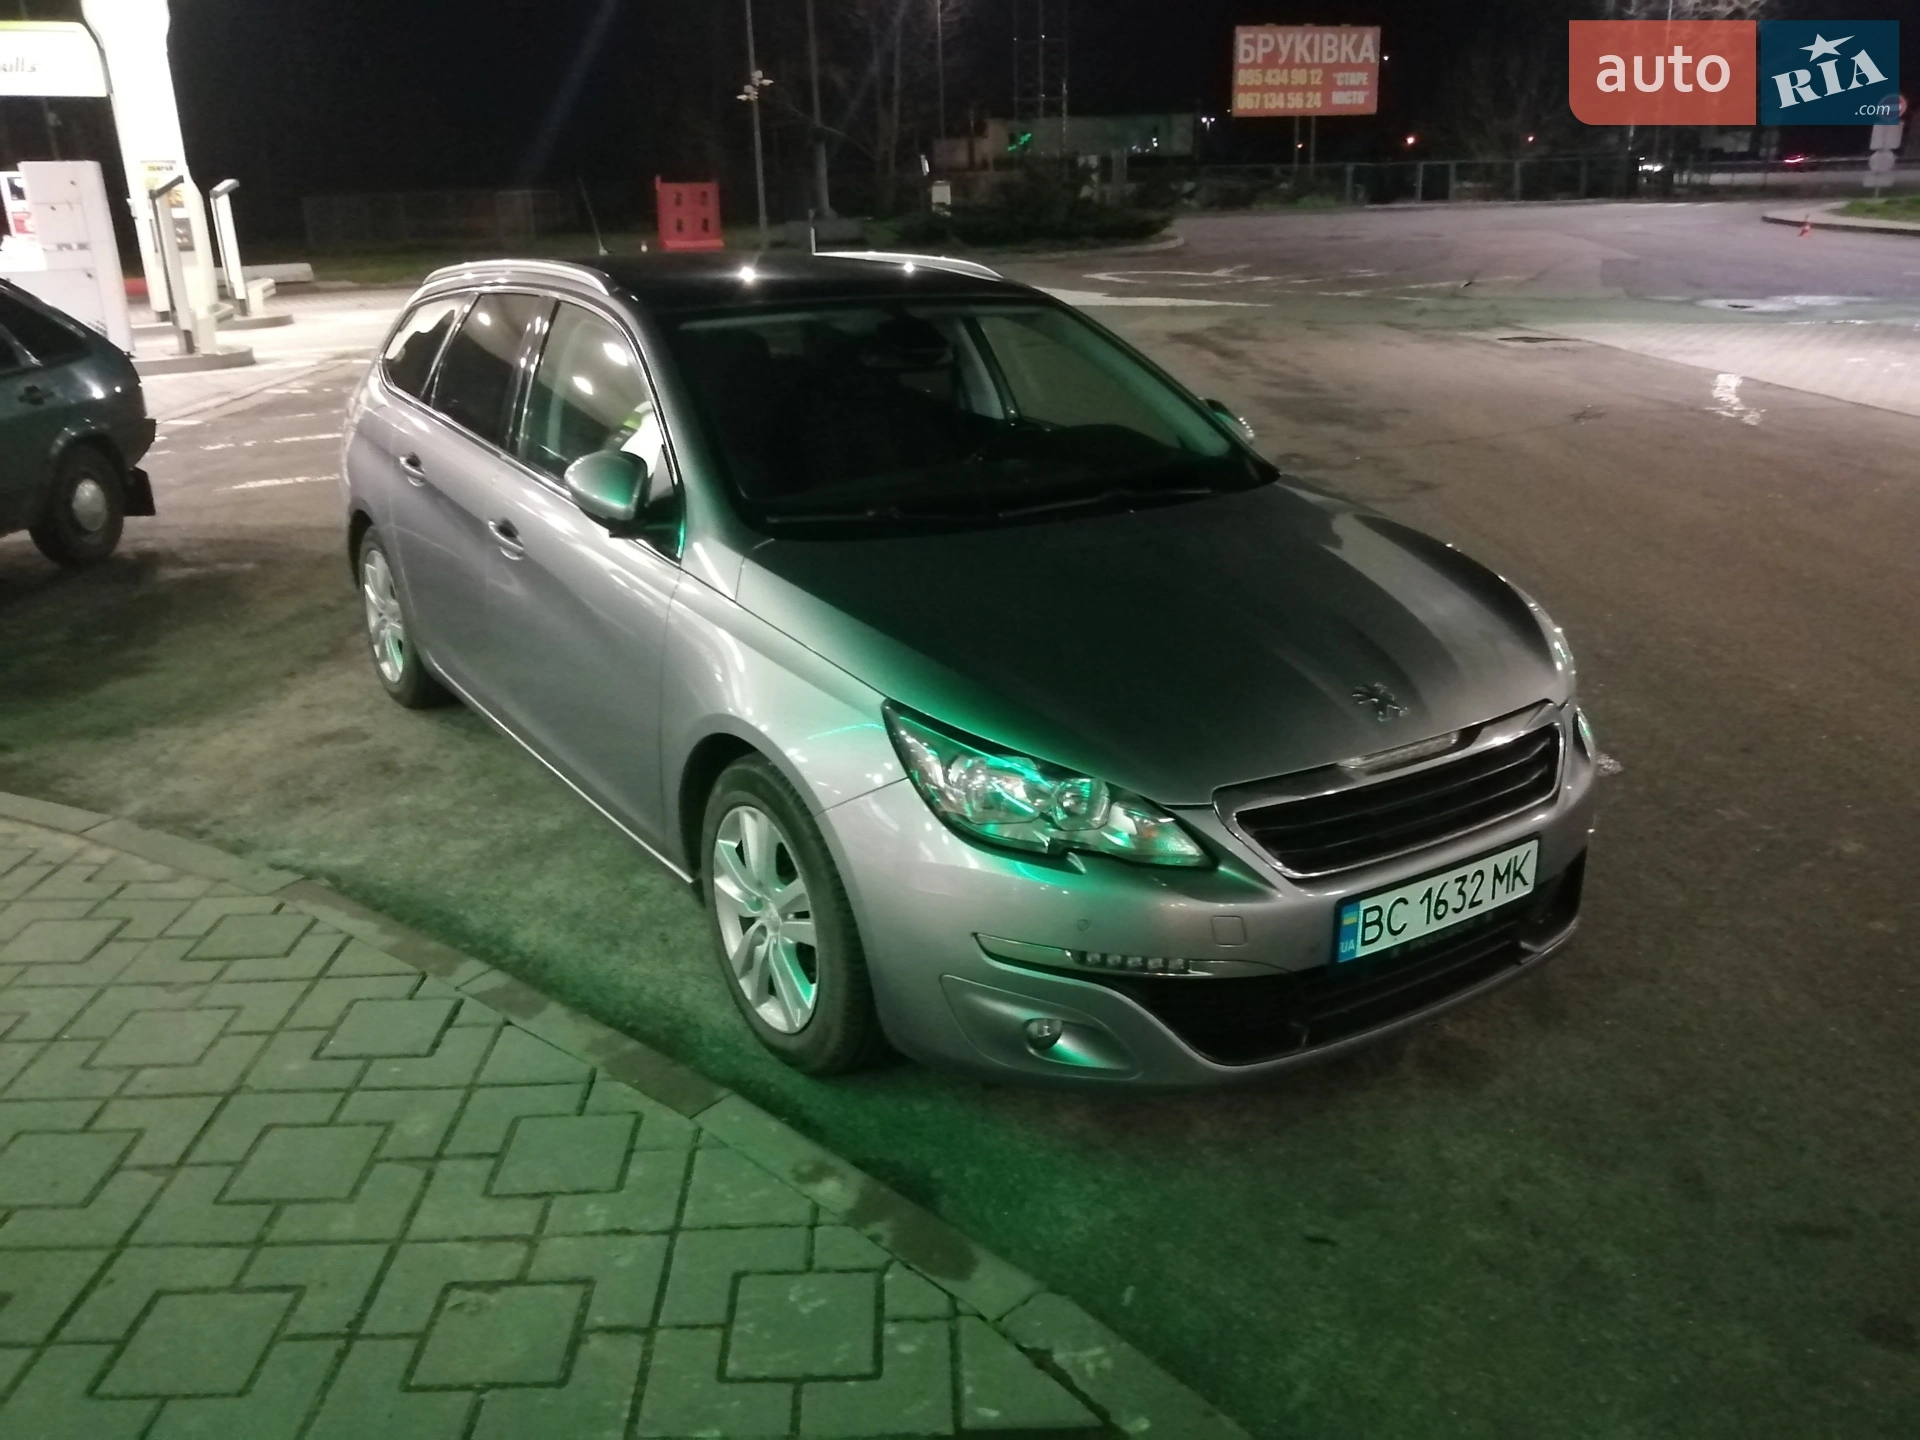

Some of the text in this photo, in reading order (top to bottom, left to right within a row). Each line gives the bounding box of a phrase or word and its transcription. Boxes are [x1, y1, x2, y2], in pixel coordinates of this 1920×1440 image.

[1238, 33, 1375, 64] БРУКІВКА
[1264, 69, 1289, 86] 434
[1309, 68, 1323, 85] 12
[1263, 92, 1285, 109] 134
[1306, 91, 1322, 108] 24
[1360, 897, 1409, 947] BC
[1419, 869, 1485, 925] 1632
[1491, 849, 1531, 900] MK
[1340, 939, 1355, 953] UA
